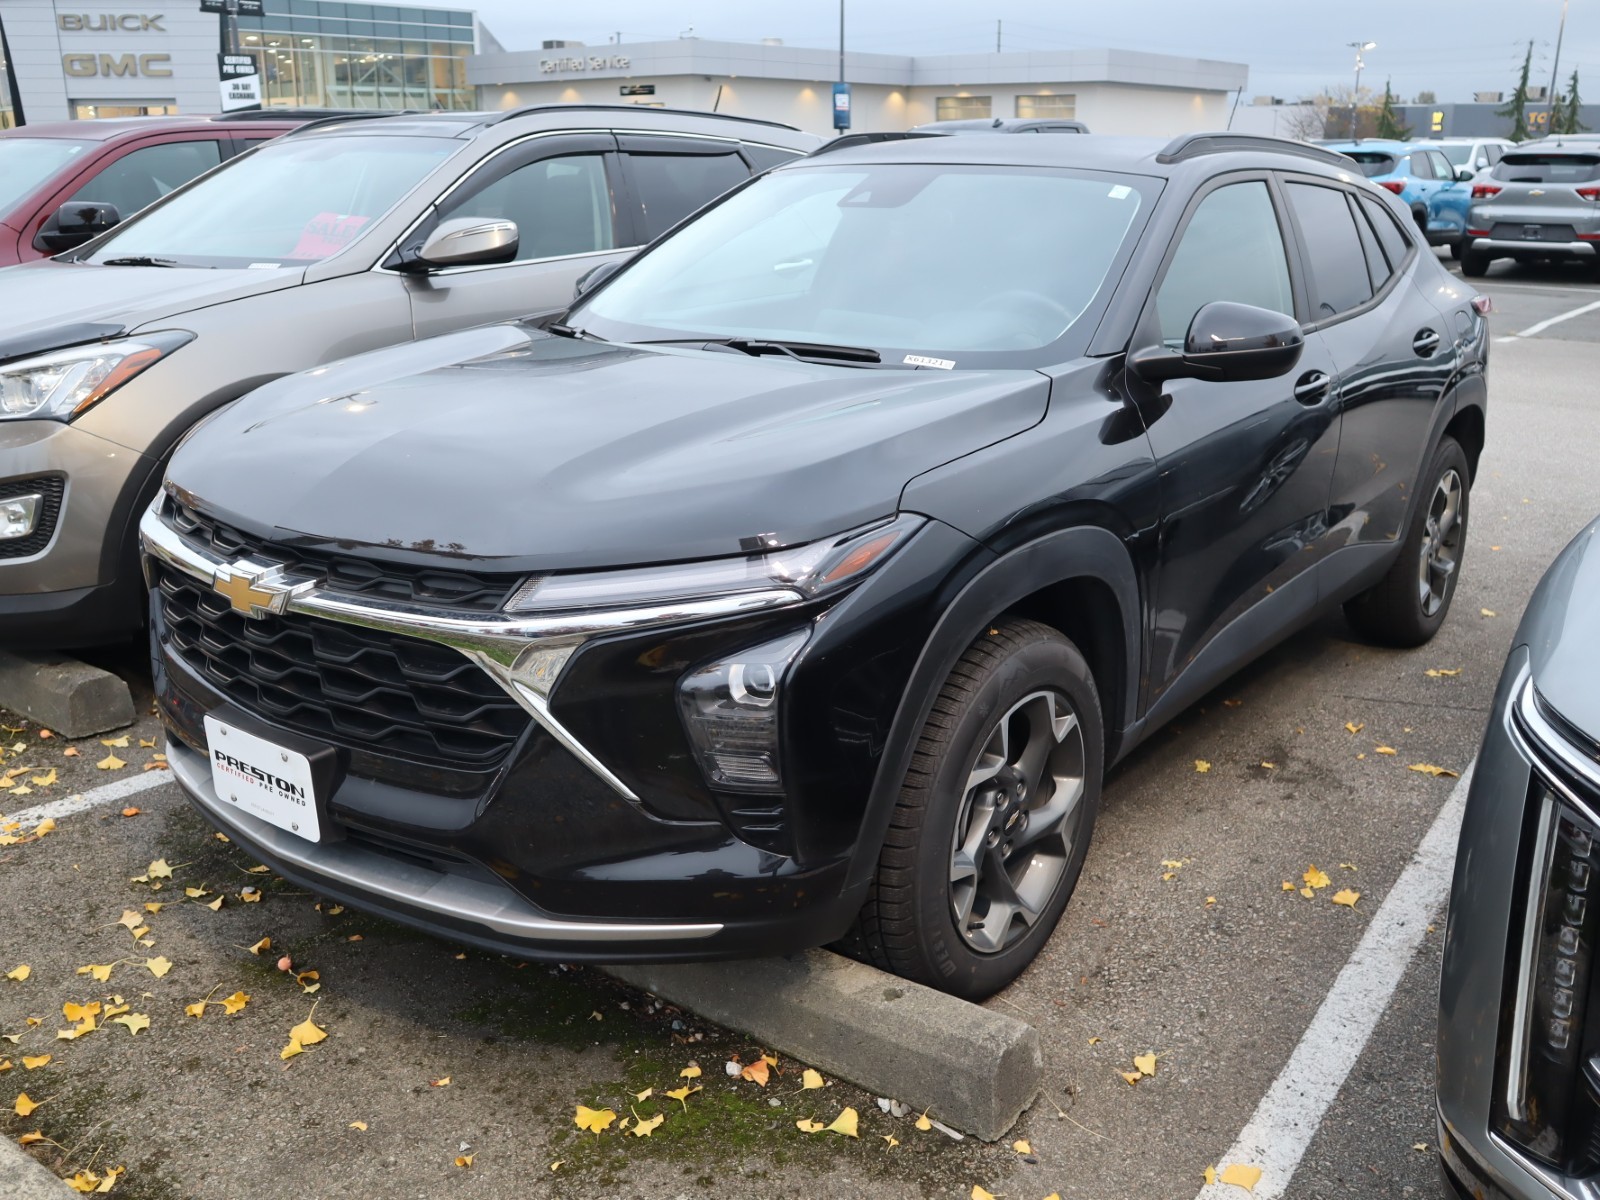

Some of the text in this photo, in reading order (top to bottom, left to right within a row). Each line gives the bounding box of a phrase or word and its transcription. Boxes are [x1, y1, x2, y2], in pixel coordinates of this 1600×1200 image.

[58, 14, 166, 32] BUICK
[62, 54, 173, 77] GMC
[539, 55, 630, 73] Certified Service
[214, 749, 306, 799] PRESTON
[216, 762, 306, 807] CERTIFIED PRE OWNED
